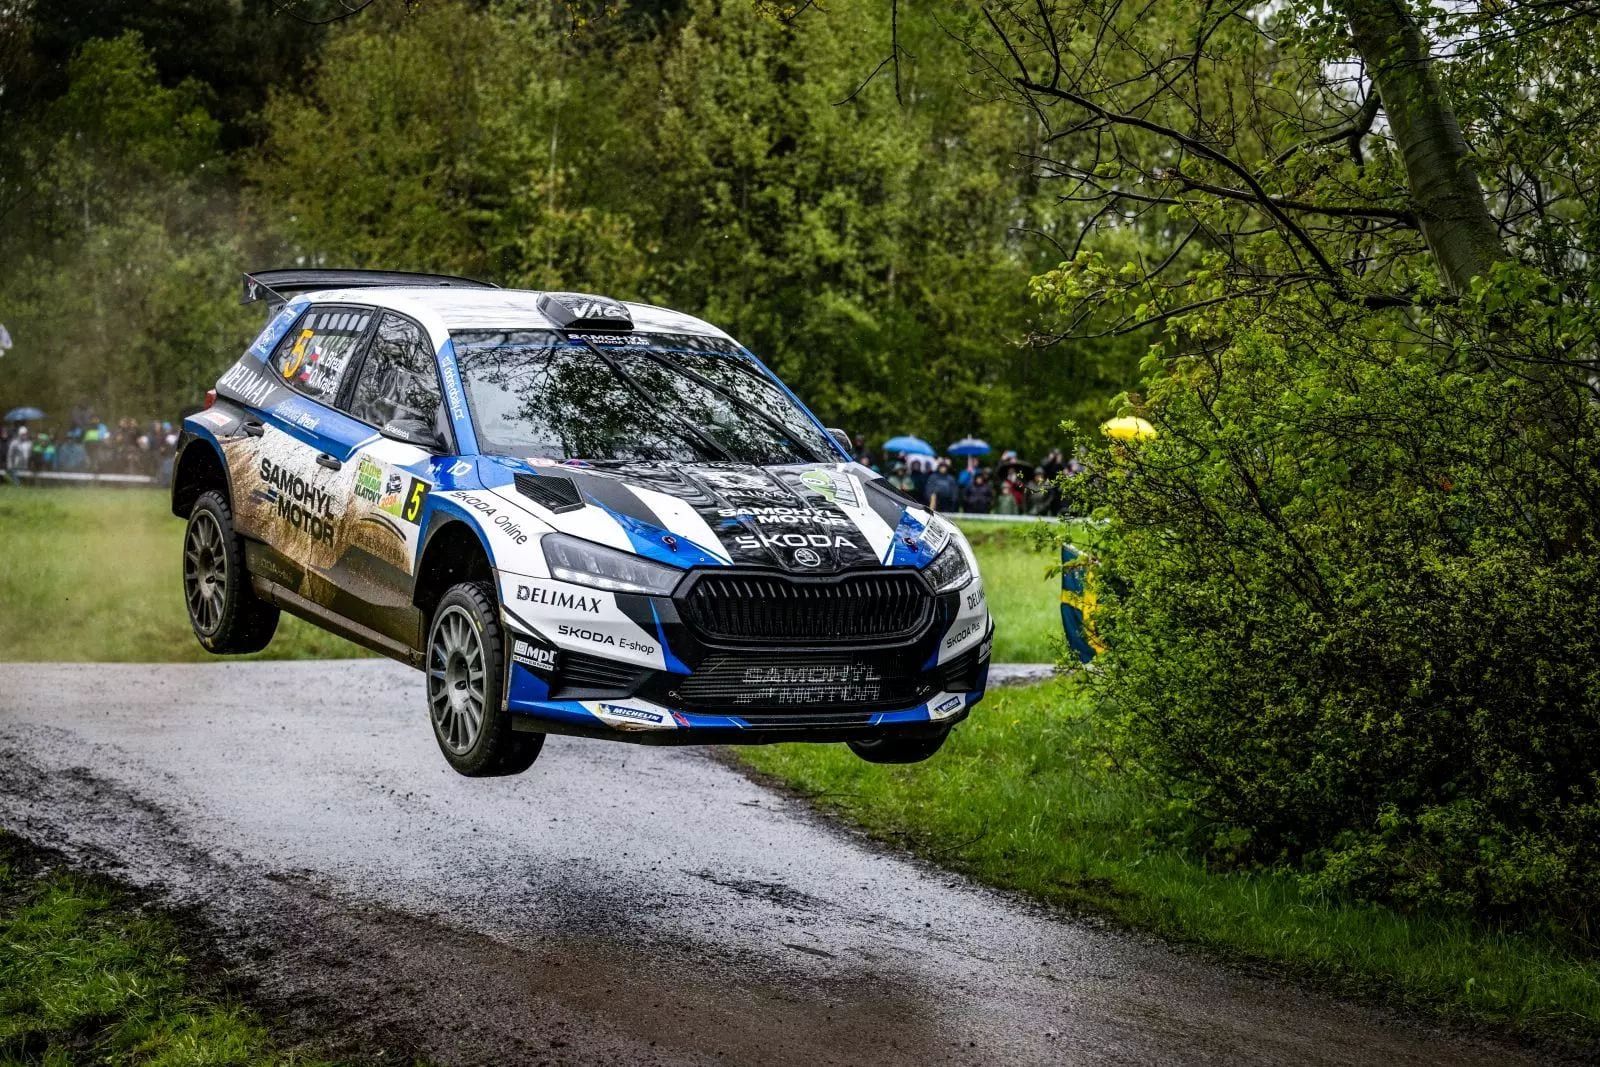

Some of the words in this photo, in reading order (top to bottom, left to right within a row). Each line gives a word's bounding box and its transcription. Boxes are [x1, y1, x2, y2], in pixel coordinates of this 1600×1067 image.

[283, 329, 314, 378] 5
[220, 361, 278, 407] DELIMAX
[354, 484, 382, 504] KLATOVY
[407, 483, 425, 521] 5
[278, 495, 335, 548] MOTOR
[494, 515, 528, 545] Online
[757, 515, 848, 526] MOTOR
[516, 585, 602, 613] DELIMAX
[619, 638, 655, 656] E-shop
[613, 707, 660, 721] MICHELIN
